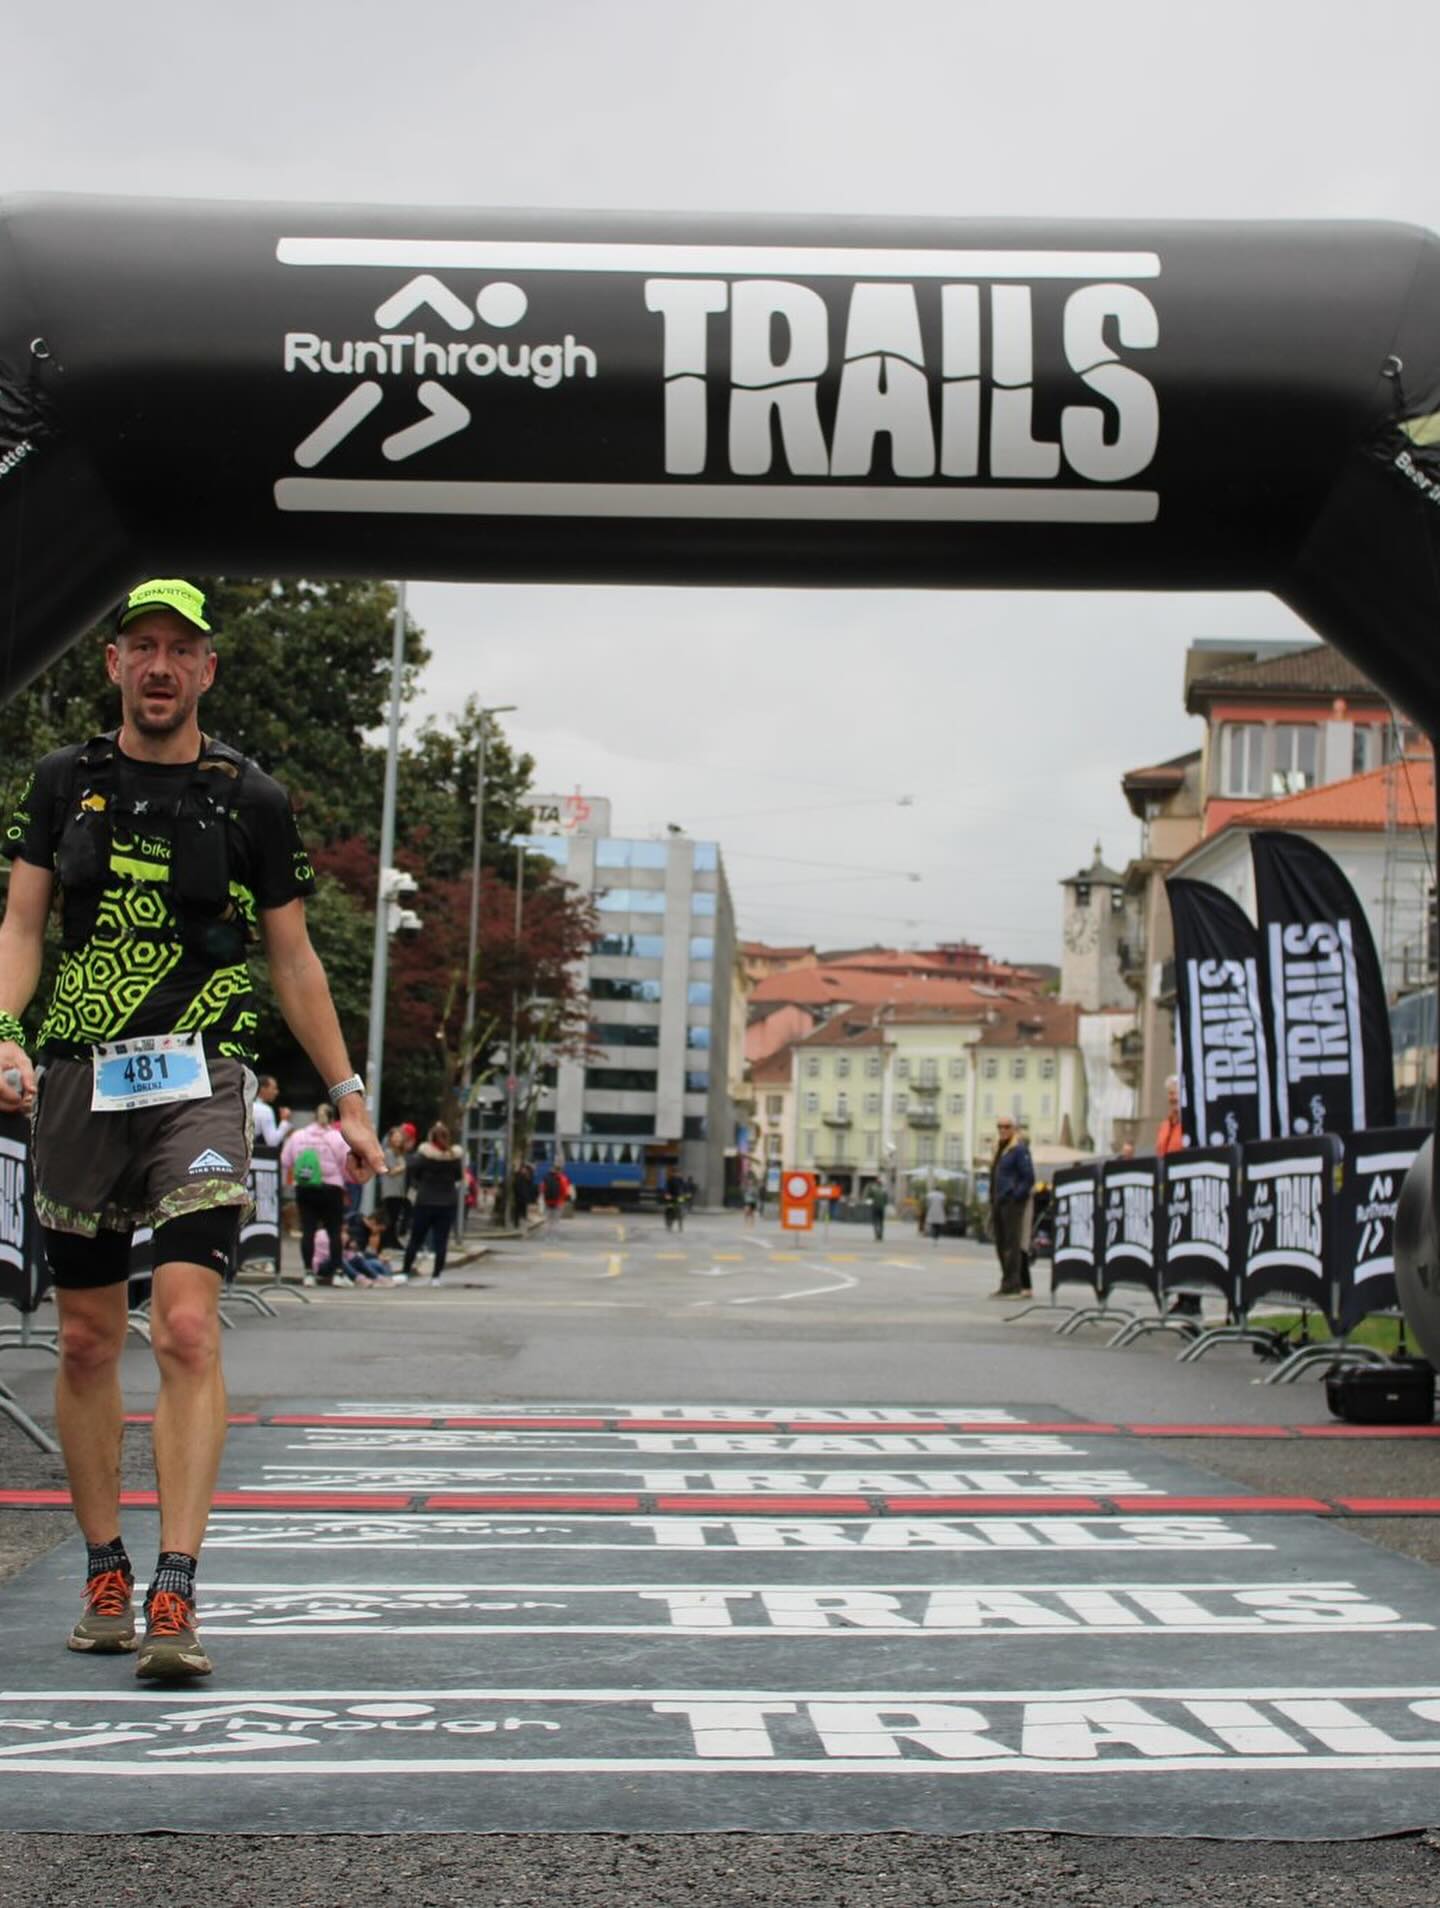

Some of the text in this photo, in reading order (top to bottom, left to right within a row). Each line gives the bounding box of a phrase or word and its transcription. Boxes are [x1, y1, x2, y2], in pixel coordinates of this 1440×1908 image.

[284, 279, 1160, 482] RunThrough TRAILS
[1282, 922, 1350, 1083] TRAILS
[1199, 959, 1258, 1101] TRAILS
[124, 1054, 168, 1083] 481
[623, 1471, 1150, 1491] TRAILS
[630, 1519, 1254, 1547] TRAILS
[638, 1588, 1402, 1628] TRAILS
[0, 1697, 1440, 1759] RunThrough TRAIL
